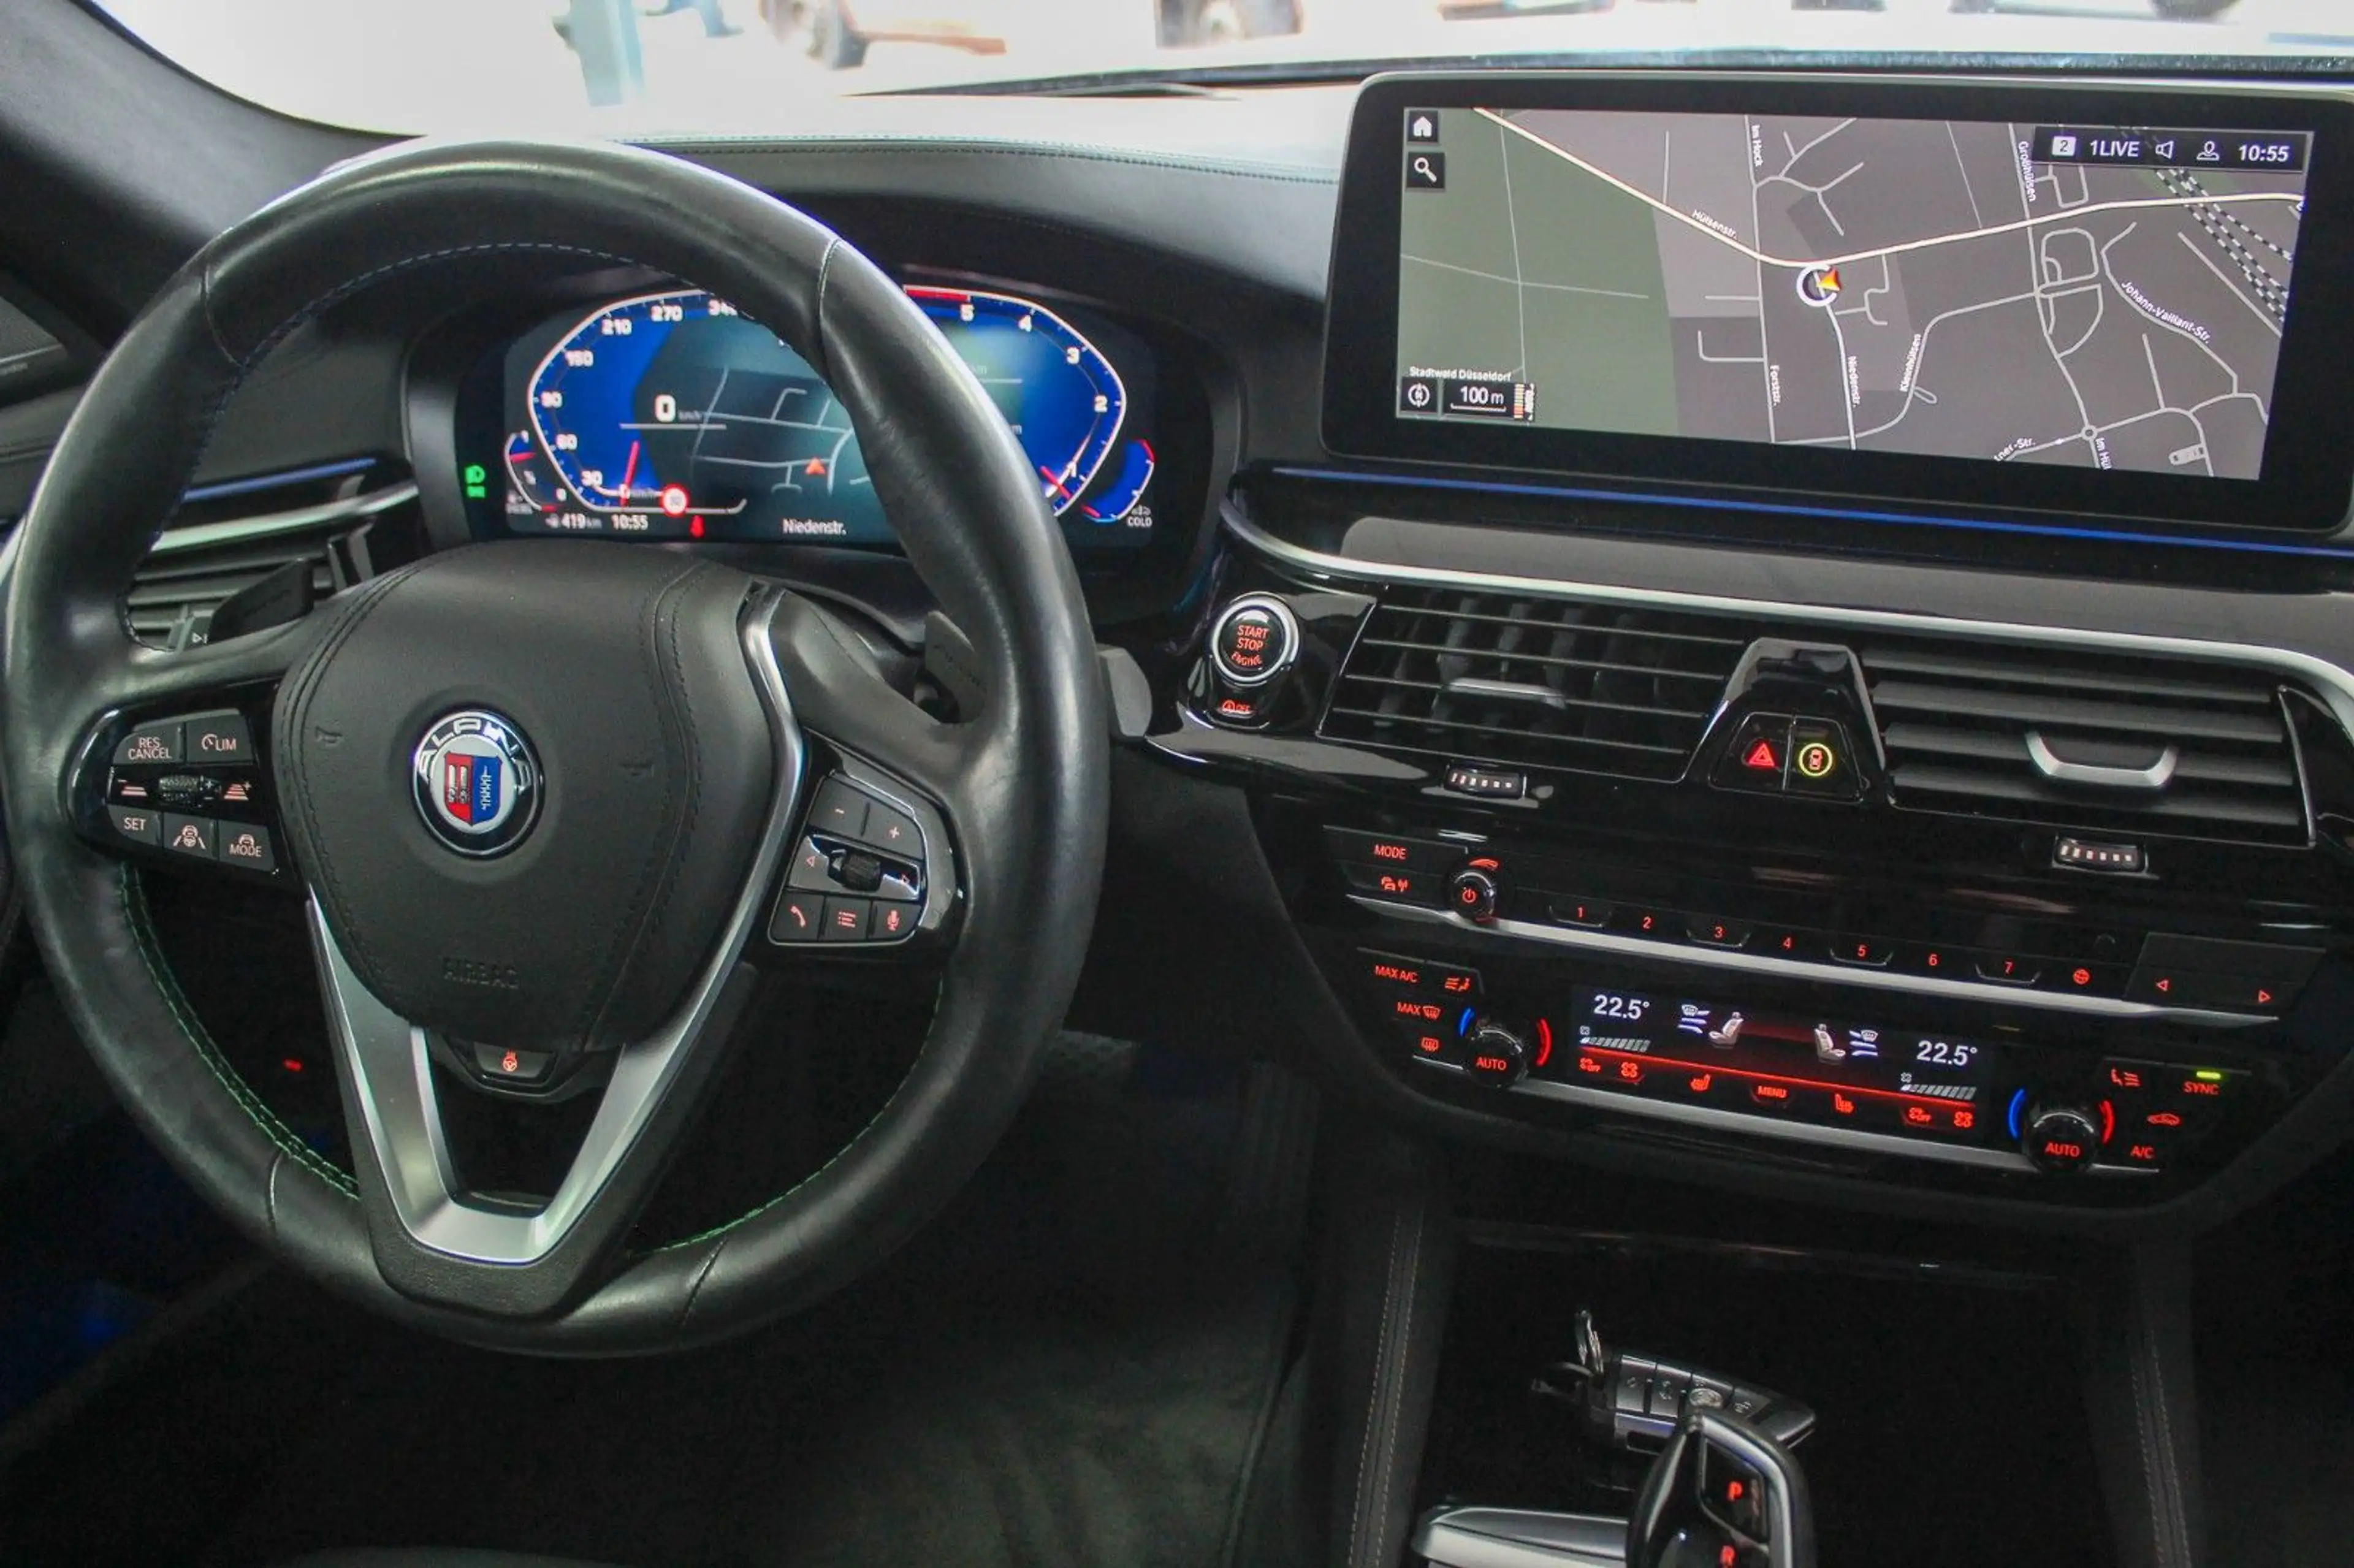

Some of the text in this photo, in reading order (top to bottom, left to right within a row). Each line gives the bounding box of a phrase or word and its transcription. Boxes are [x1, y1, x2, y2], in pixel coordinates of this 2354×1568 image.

[1751, 124, 1760, 139] Im
[2059, 140, 2069, 153] 2
[2090, 140, 2141, 158] 1LIVE
[2238, 144, 2290, 162] 10:55
[1692, 210, 1739, 242] Hülsenstr.
[651, 305, 683, 322] 270
[960, 303, 975, 321] 5
[2121, 281, 2211, 343] Johann-Vaillant-Str.
[601, 319, 632, 335] 210
[1018, 314, 1032, 332] 4
[1066, 346, 1080, 364] 3
[1409, 366, 1512, 381] Stadtwald Düsseldorf
[1770, 365, 1780, 407] Forststr.
[1848, 356, 1861, 408] Niedenstr.
[1460, 386, 1504, 404] 100 m
[655, 394, 676, 422] 0
[1094, 394, 1108, 413] 2
[561, 513, 586, 530] 419
[611, 514, 649, 530] 10:55
[783, 519, 847, 535] Niedenstr.
[1127, 517, 1152, 528] COLD
[1237, 625, 1270, 638] START
[1237, 637, 1263, 650] STOP
[1231, 652, 1263, 666] ENGINE
[139, 737, 161, 748] RES
[216, 737, 237, 751] LIM
[128, 747, 172, 760] CANCEL
[419, 717, 532, 796] ALPINA
[124, 817, 147, 831] SET
[229, 843, 262, 857] MODE
[1374, 844, 1407, 859] MODE
[1577, 907, 1583, 918] 1
[1642, 916, 1651, 929] 2
[1715, 926, 1723, 938] 3
[1783, 937, 1792, 949] 4
[1857, 945, 1866, 957] 5
[1929, 954, 1938, 966] 6
[1375, 965, 1418, 983] MAX A/C
[2005, 962, 2013, 974] 7
[1398, 1002, 1421, 1016] MAX
[1594, 994, 1650, 1019] 22.5°
[1916, 1040, 1978, 1066] 22.5°
[1476, 1057, 1507, 1070] AUTO
[1758, 1085, 1788, 1098] MENU
[2184, 1081, 2220, 1095] SYNC
[2045, 1142, 2081, 1157] AUTO
[2130, 1145, 2154, 1159] A/C
[1727, 1480, 1743, 1501] P
